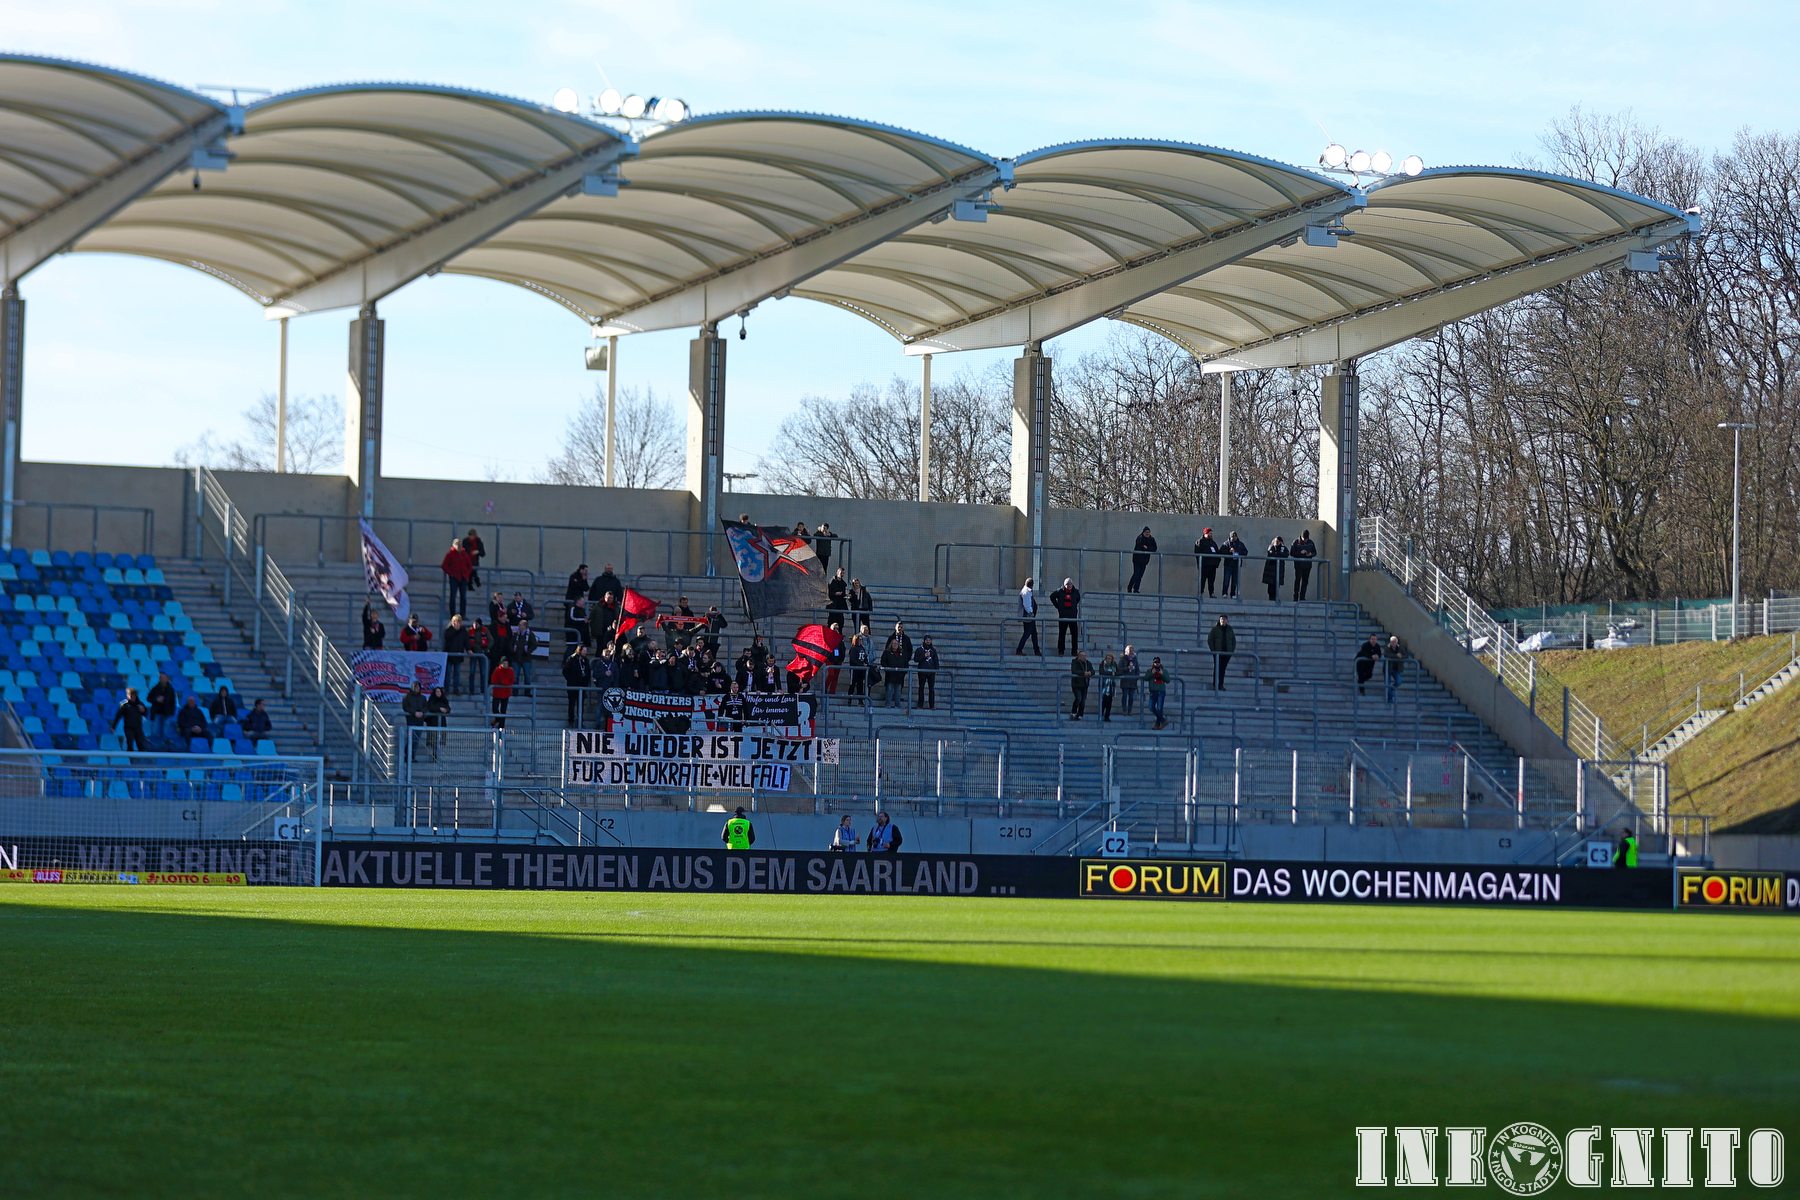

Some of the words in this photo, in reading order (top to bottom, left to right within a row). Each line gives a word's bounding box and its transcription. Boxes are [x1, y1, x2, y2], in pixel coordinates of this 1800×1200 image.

[625, 690, 692, 706] SUPPORTERS
[624, 706, 692, 719] INGOLST
[766, 706, 789, 714] immer
[576, 732, 615, 755] NIE
[625, 733, 704, 759] WIEDER
[710, 735, 743, 760] IST
[182, 809, 197, 821] C1
[600, 818, 614, 829] C2
[278, 824, 300, 840] C1
[1105, 838, 1125, 853] C2
[1498, 837, 1512, 848] C3
[1590, 848, 1608, 863] C3
[36, 870, 60, 881] ALLES
[79, 845, 145, 872] WIR
[160, 847, 312, 883] BRINGEN
[323, 850, 496, 885] AKTUELLE
[503, 853, 639, 888] THEMEN
[648, 854, 714, 889] AUS
[725, 856, 795, 891] DEM
[807, 858, 978, 894] SAARLAND
[162, 874, 199, 883] LOTTO
[202, 875, 210, 884] 6
[226, 875, 241, 884] 49
[1085, 865, 1220, 894] FORUM
[1232, 867, 1291, 897] DAS
[1302, 869, 1561, 901] WOCHENMAGAZIN
[1683, 876, 1781, 906] FORUM
[1787, 878, 1800, 907] D
